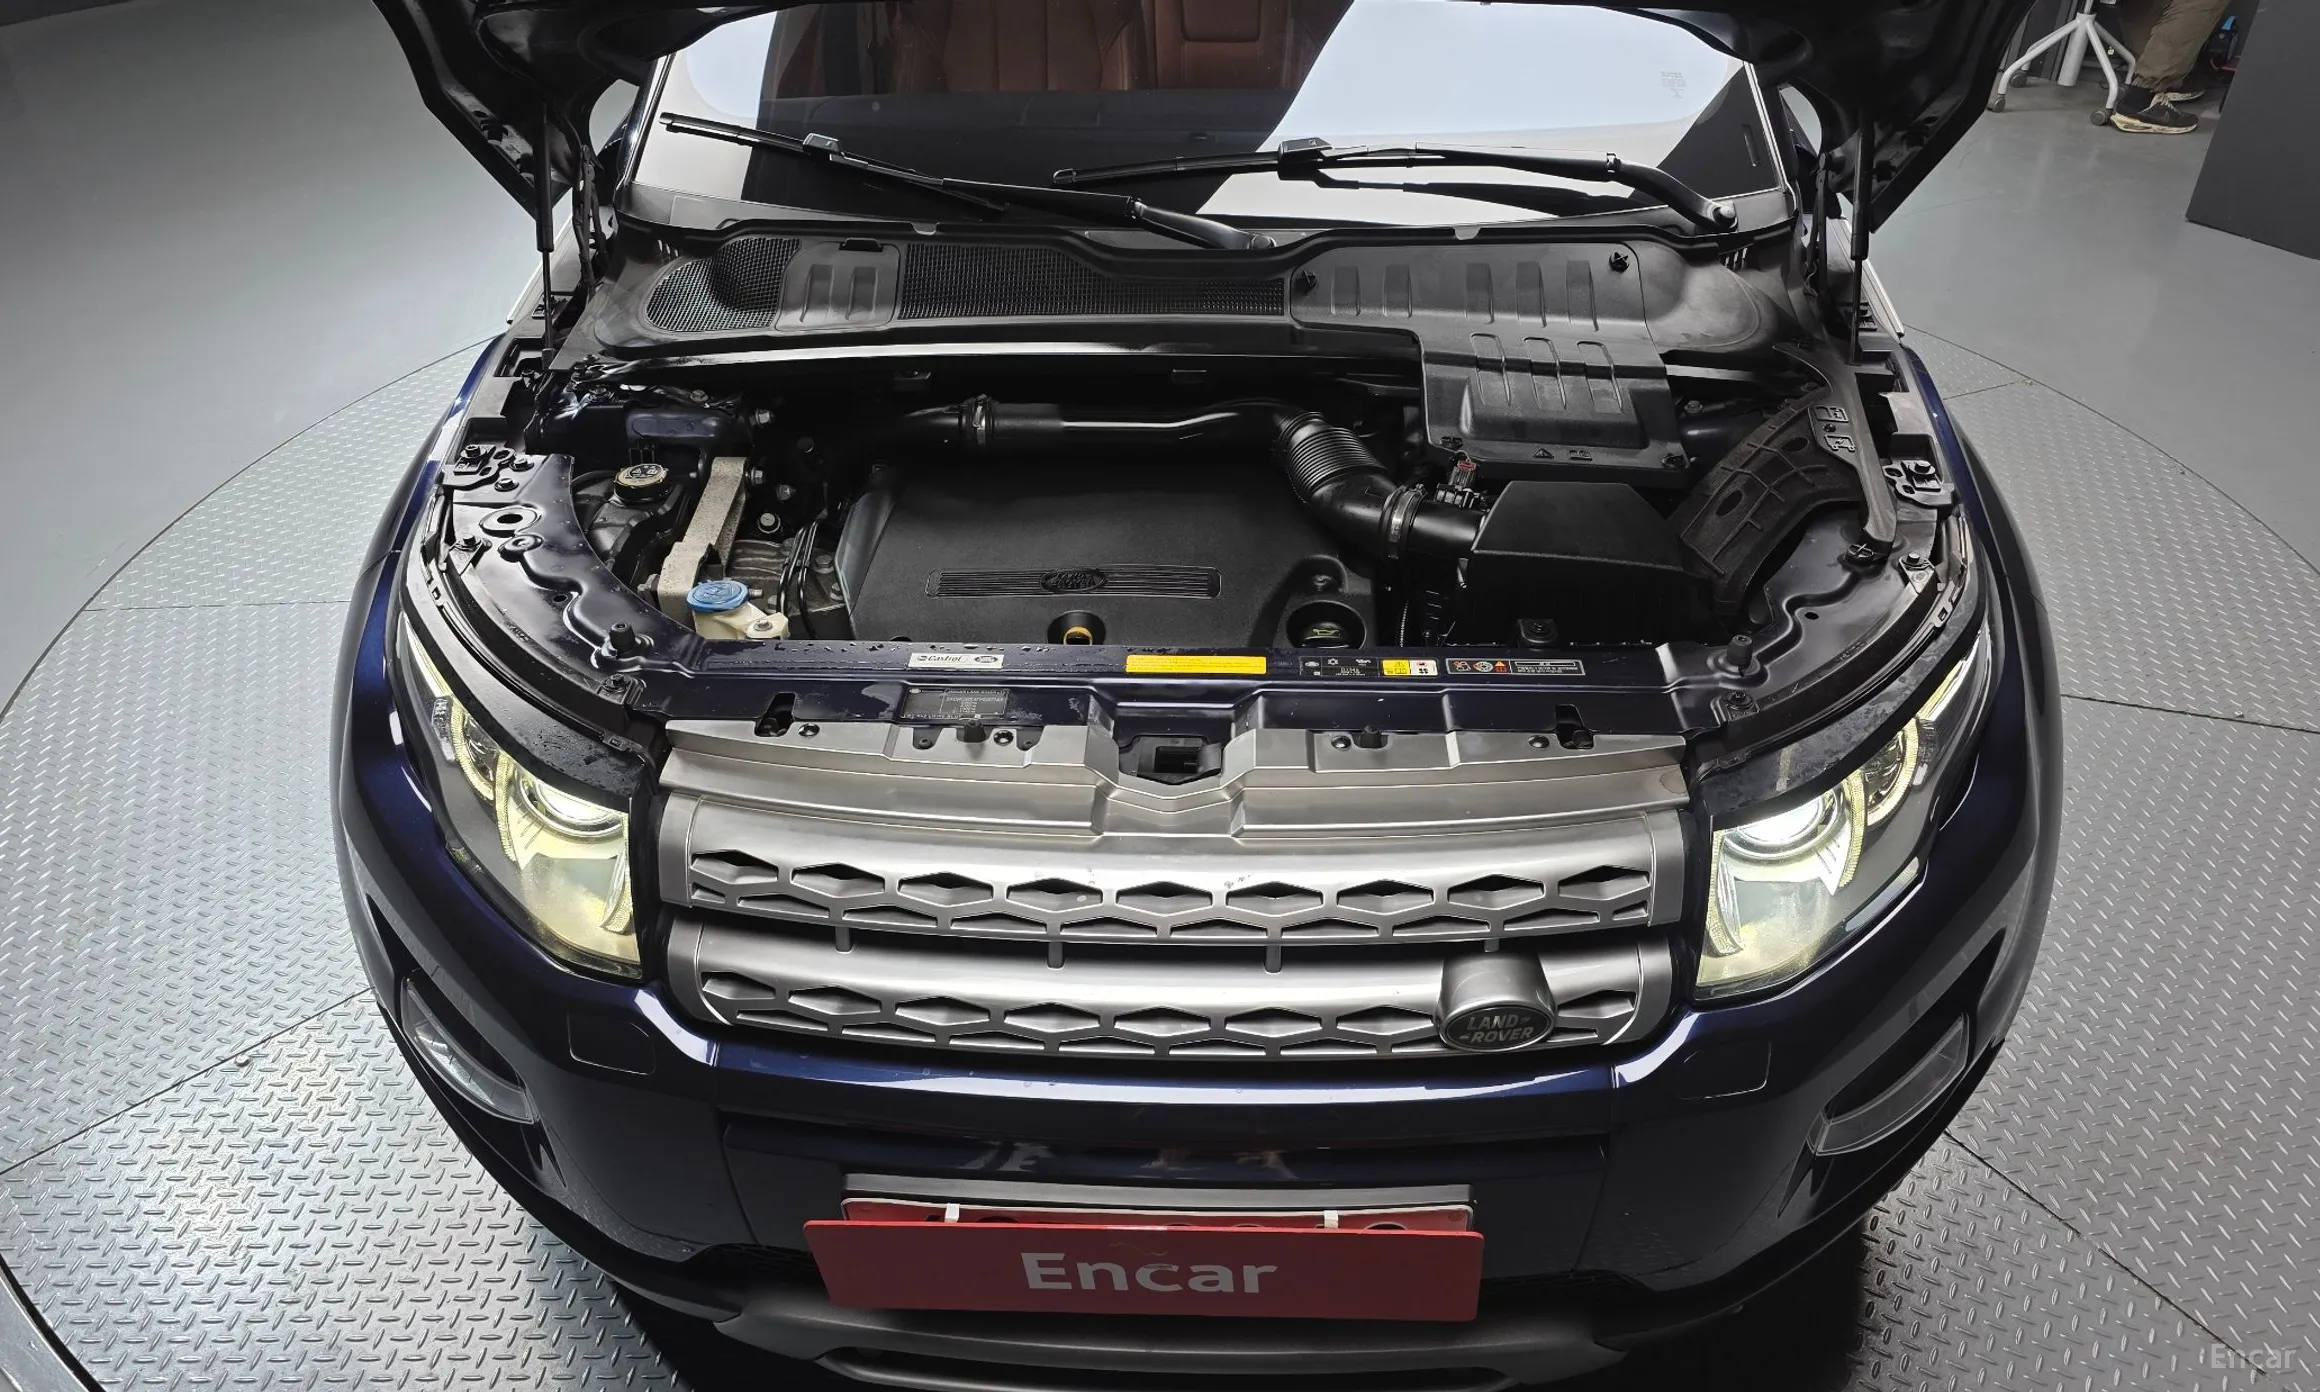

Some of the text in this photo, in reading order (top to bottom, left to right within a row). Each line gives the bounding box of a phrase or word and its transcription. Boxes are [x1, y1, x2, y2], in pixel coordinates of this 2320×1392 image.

[928, 655, 961, 663] Castrol
[1466, 1013, 1519, 1031] LAND
[1469, 1026, 1534, 1043] ROVER
[1020, 1251, 1279, 1295] Encar
